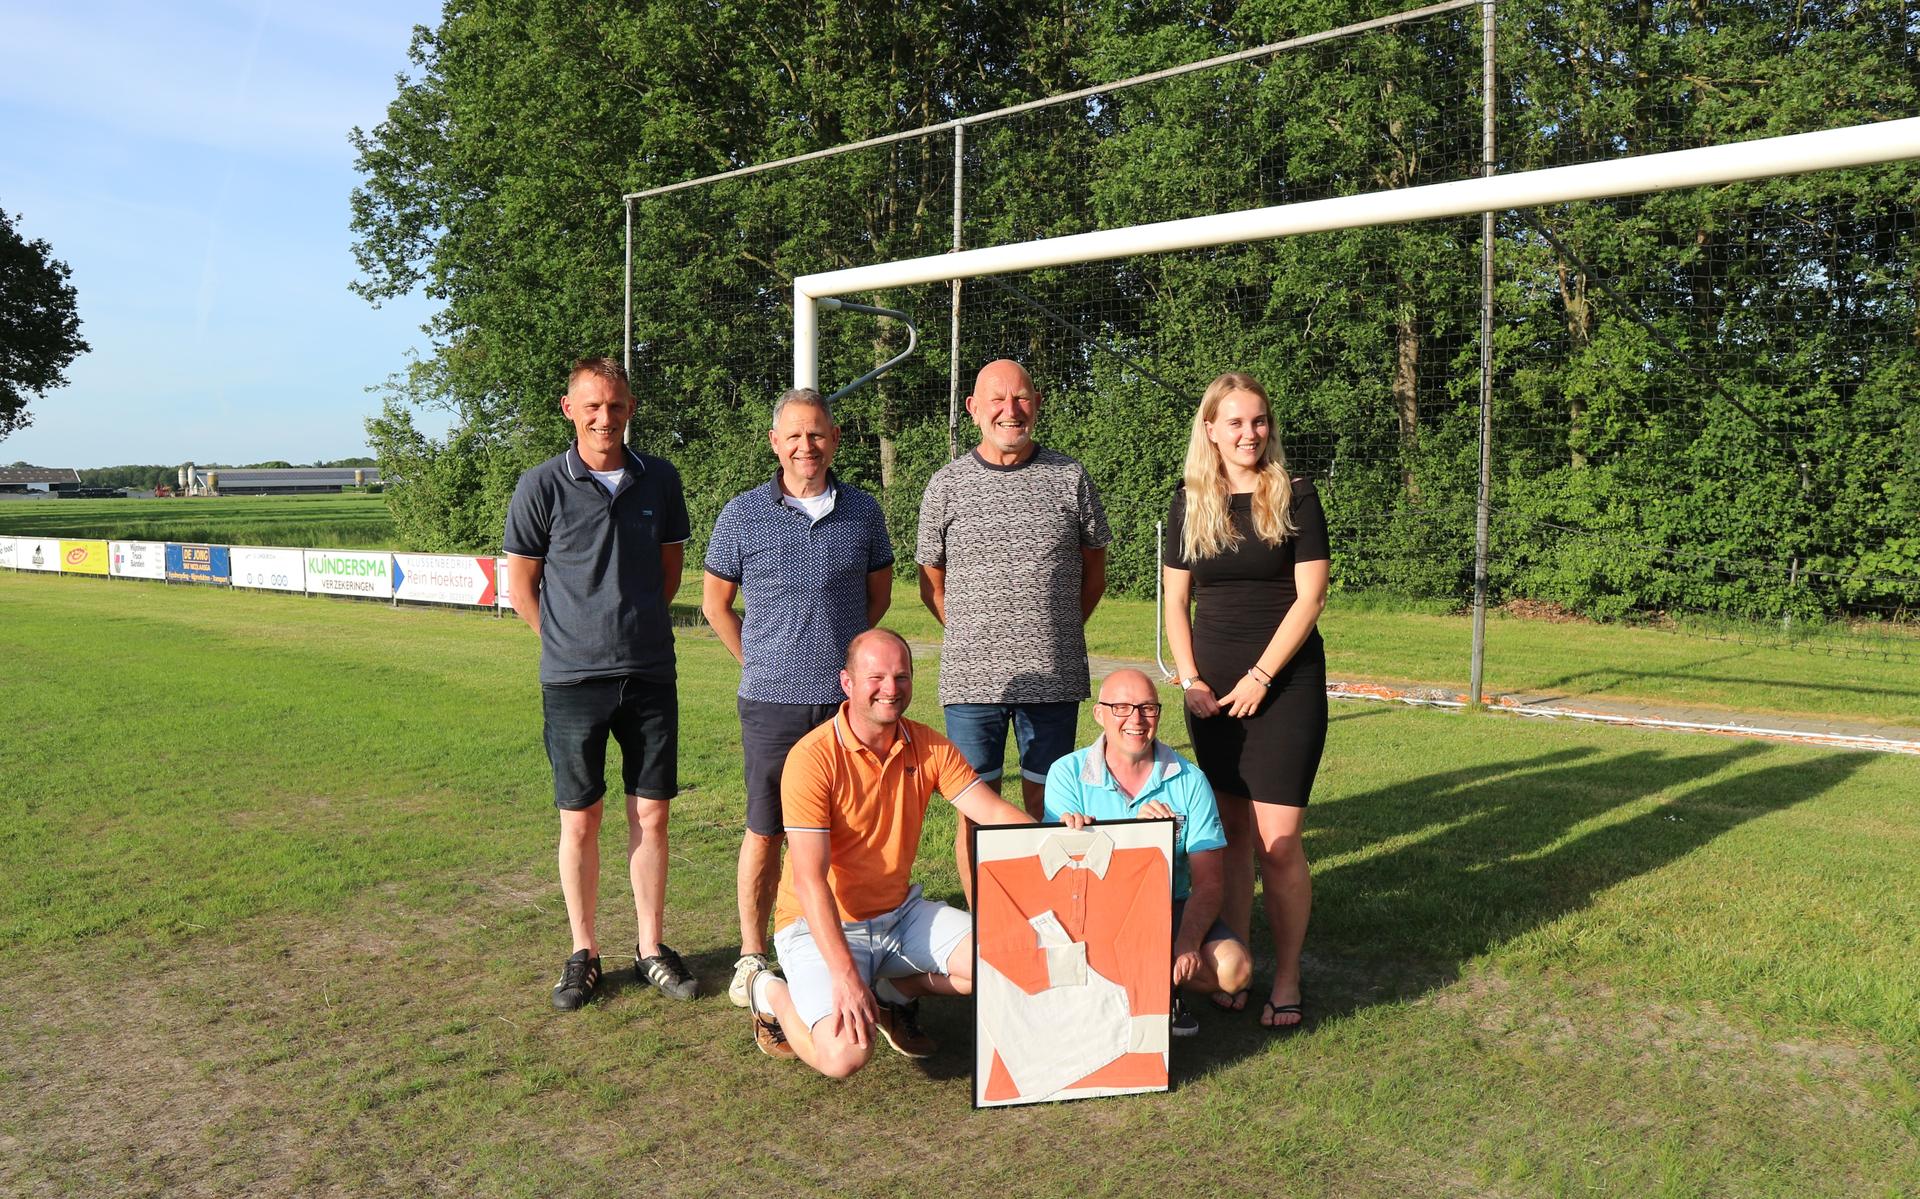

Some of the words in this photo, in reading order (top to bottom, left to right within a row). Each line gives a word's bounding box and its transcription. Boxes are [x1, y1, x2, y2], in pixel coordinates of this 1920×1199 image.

[184, 549, 192, 560] DE
[193, 550, 209, 561] JONG
[407, 570, 428, 585] Rein
[430, 571, 473, 588] Hoekstra
[322, 580, 375, 592] VERZEKERINGEN
